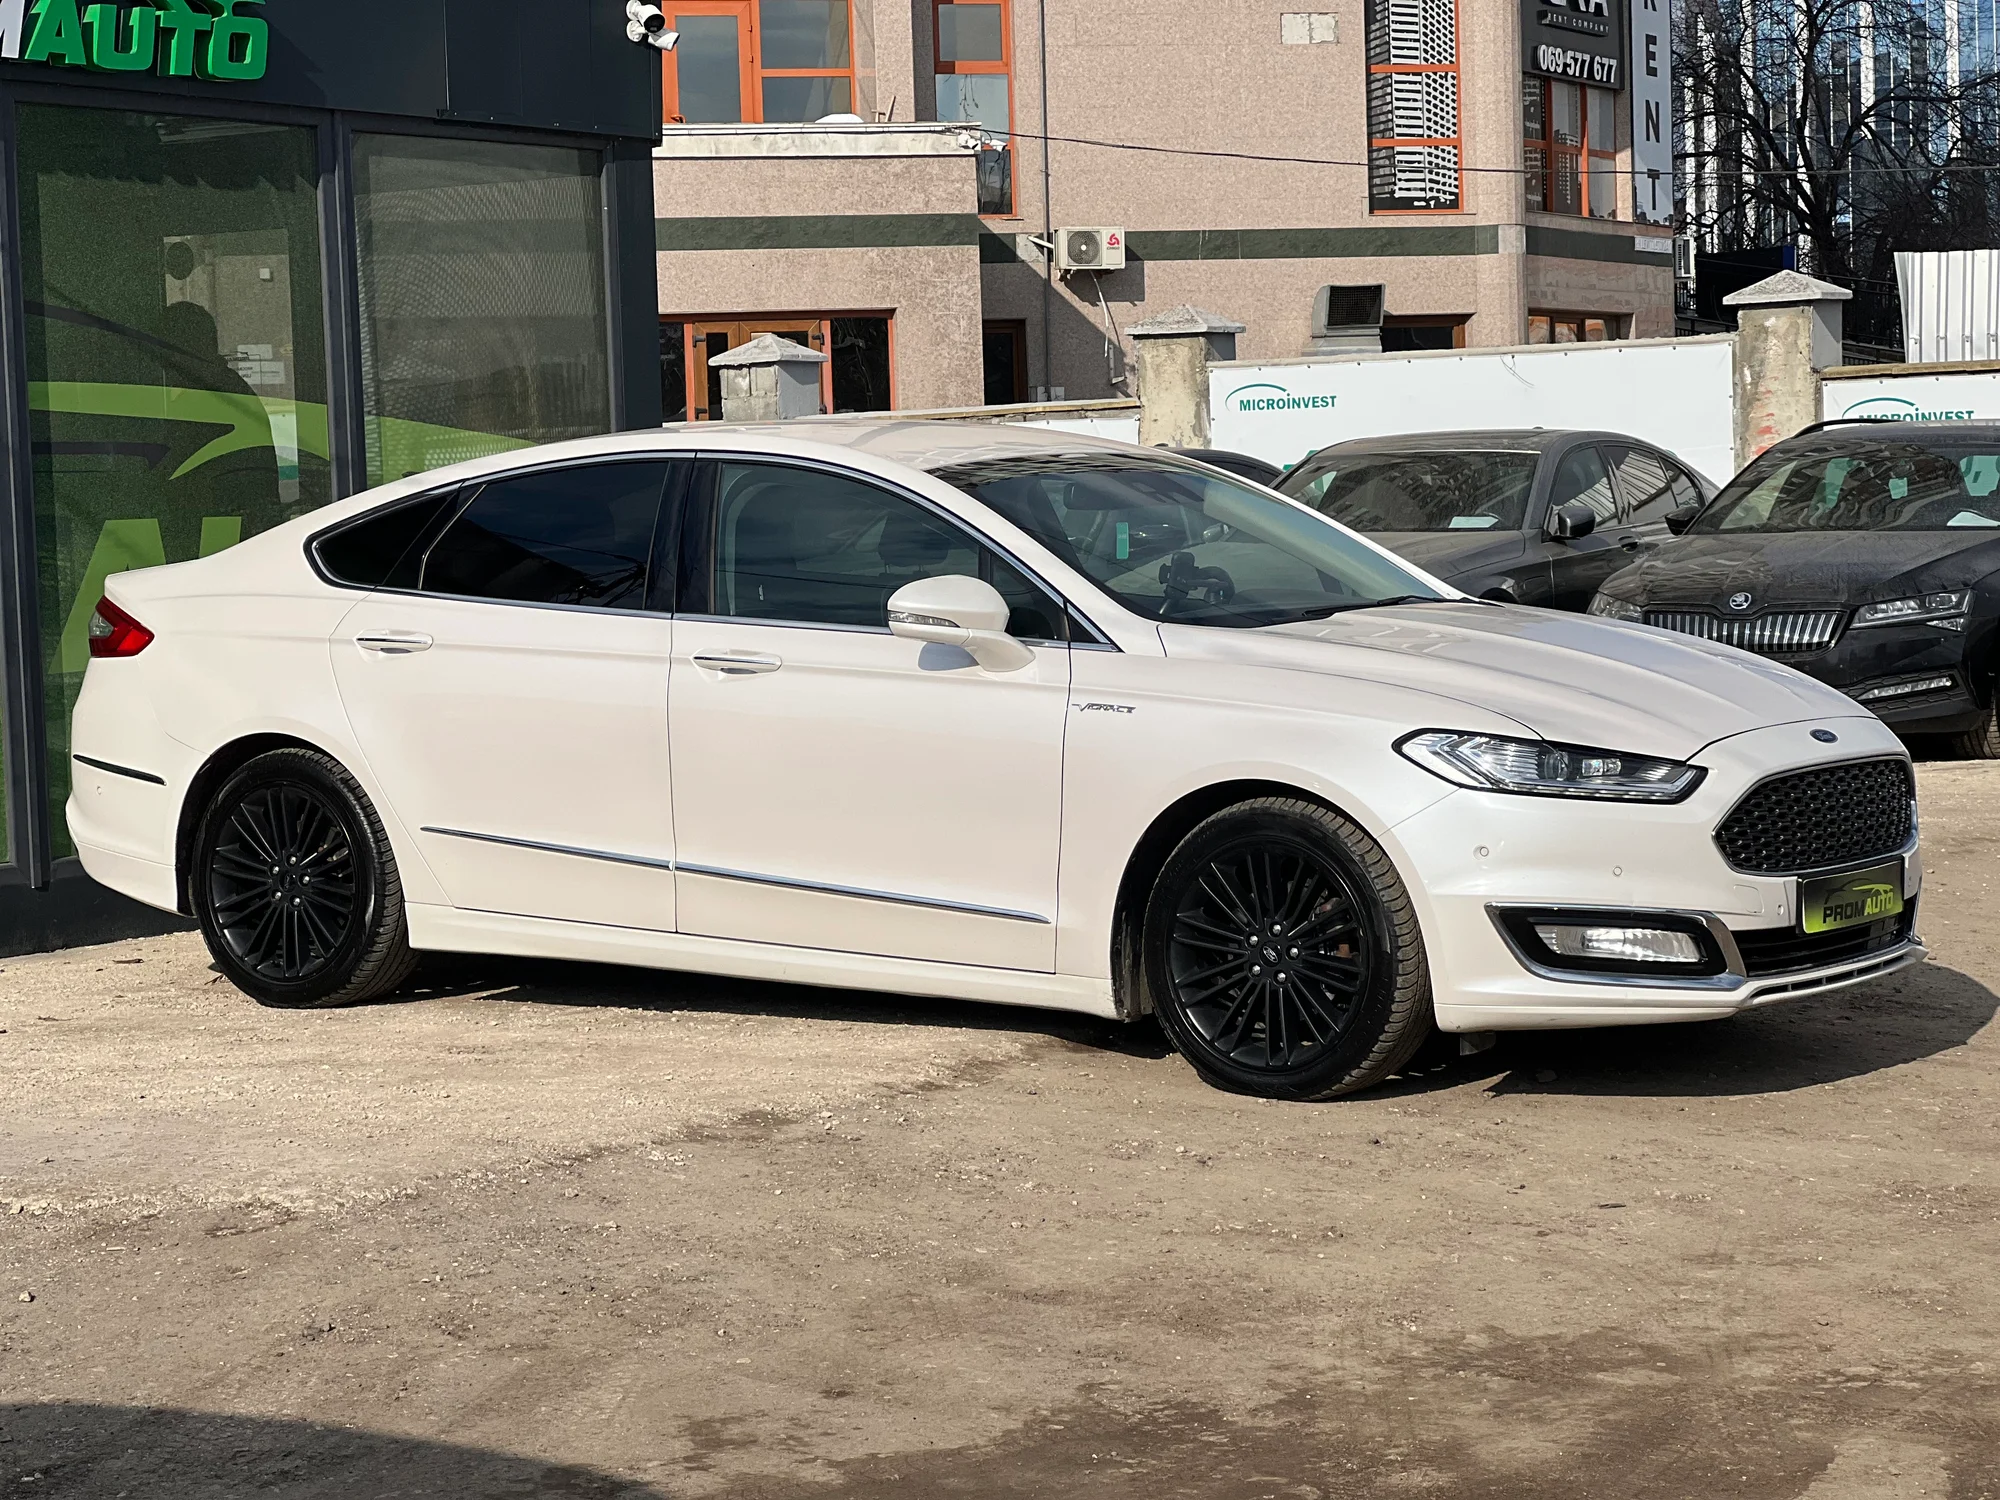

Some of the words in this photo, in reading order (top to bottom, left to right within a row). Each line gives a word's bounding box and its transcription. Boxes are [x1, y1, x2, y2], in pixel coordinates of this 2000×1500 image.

[1572, 18, 1609, 33] COMPANY
[1538, 44, 1563, 73] 069
[1566, 50, 1590, 78] 577
[1594, 55, 1617, 83] 677
[1643, 0, 1660, 211] ENT
